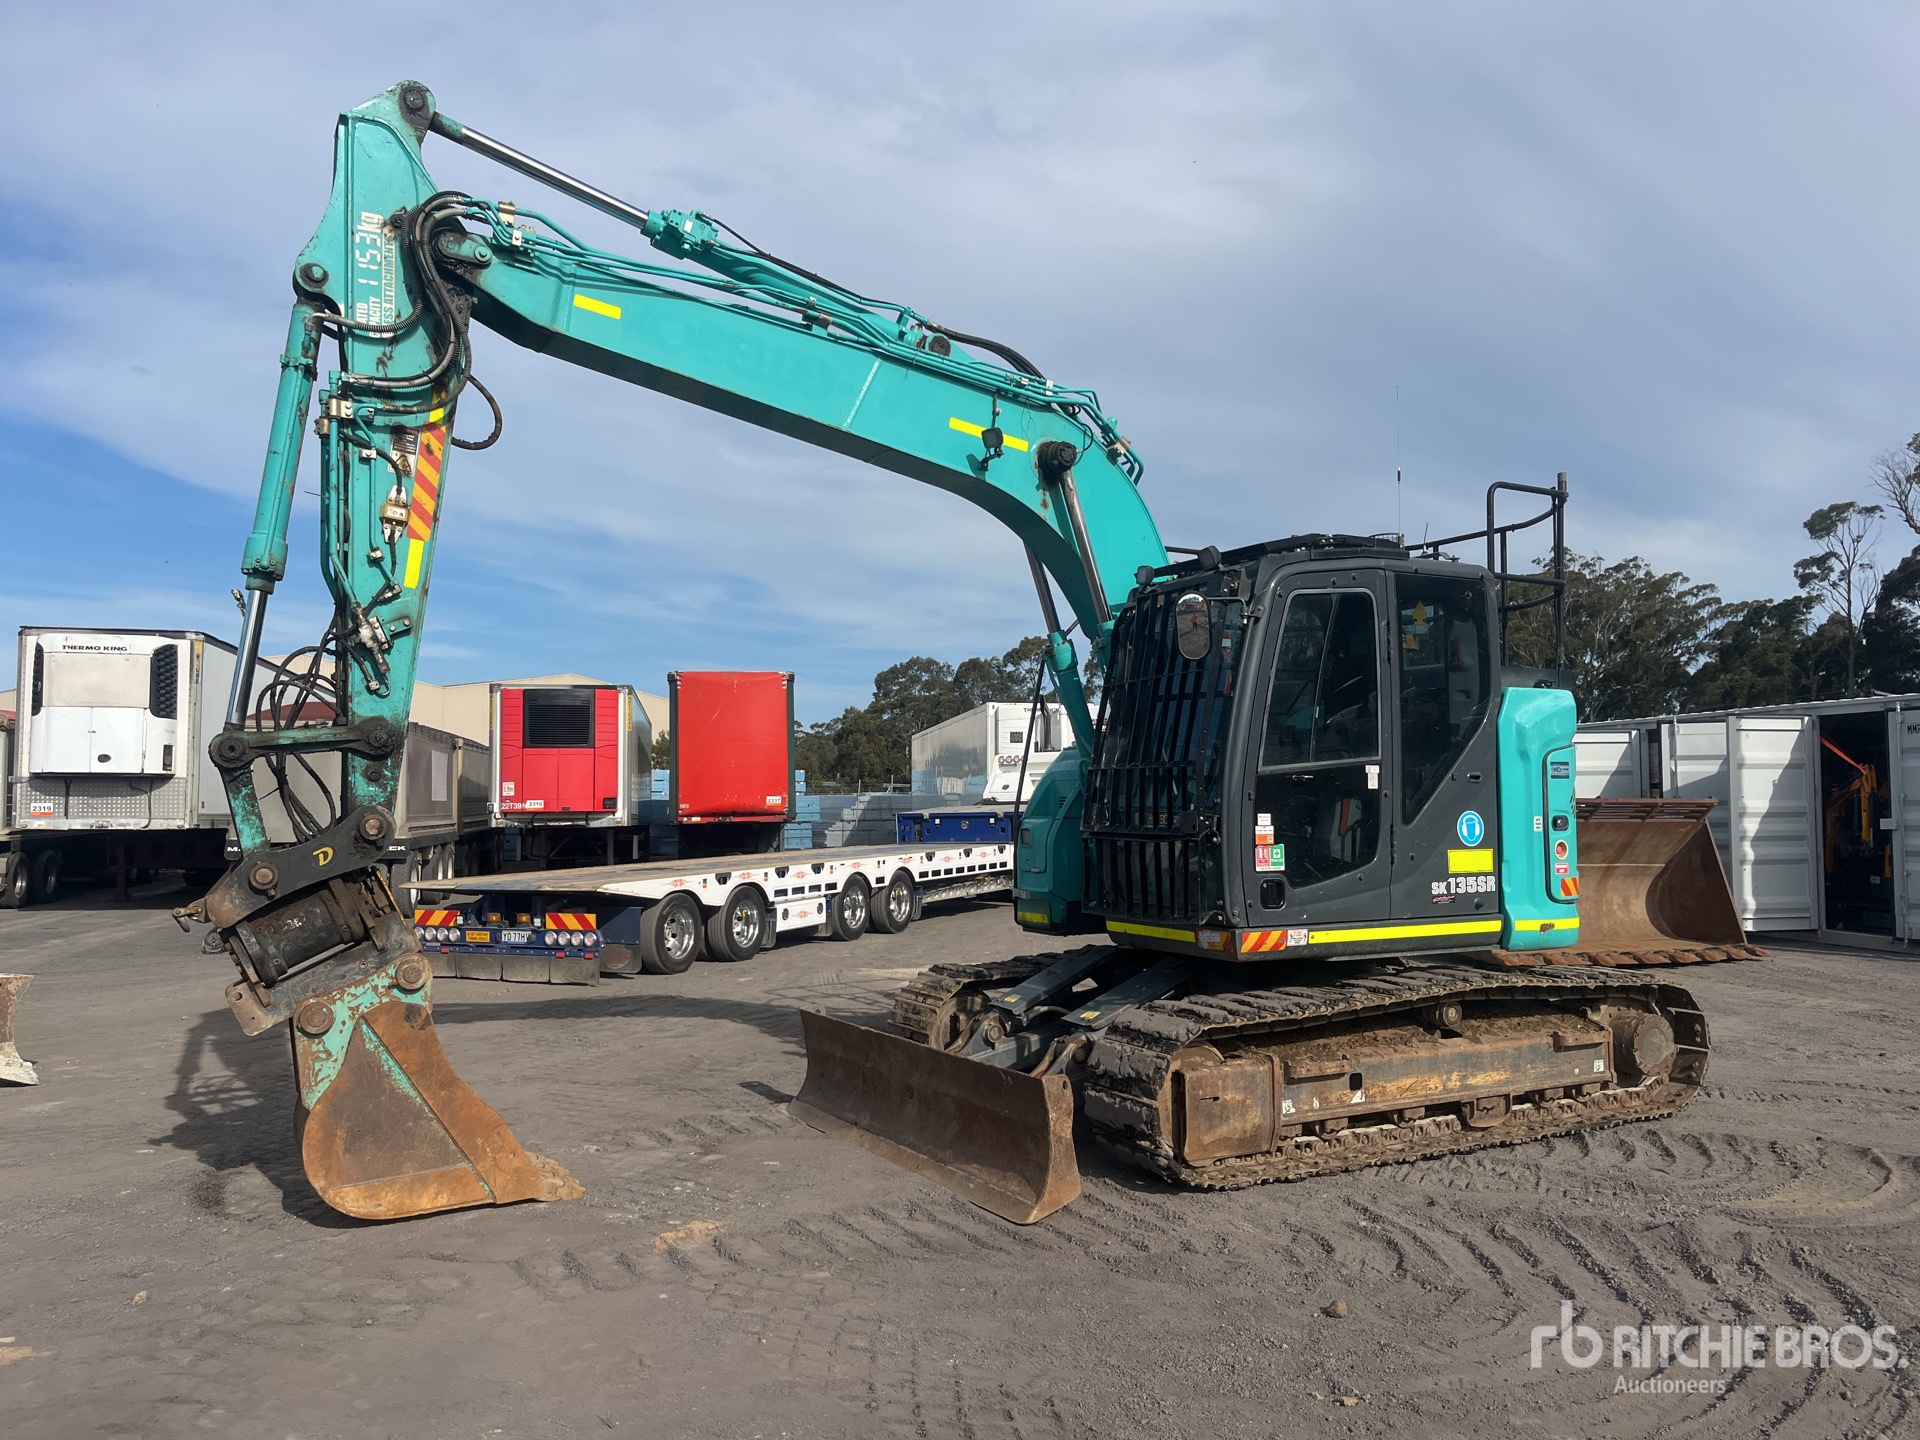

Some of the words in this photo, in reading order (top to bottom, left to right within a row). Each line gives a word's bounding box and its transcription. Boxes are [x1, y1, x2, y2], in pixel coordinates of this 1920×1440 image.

[356, 302, 369, 325] ATED
[368, 296, 381, 338] CPACITY
[383, 306, 394, 326] ESS
[1431, 875, 1496, 895] SK135SR
